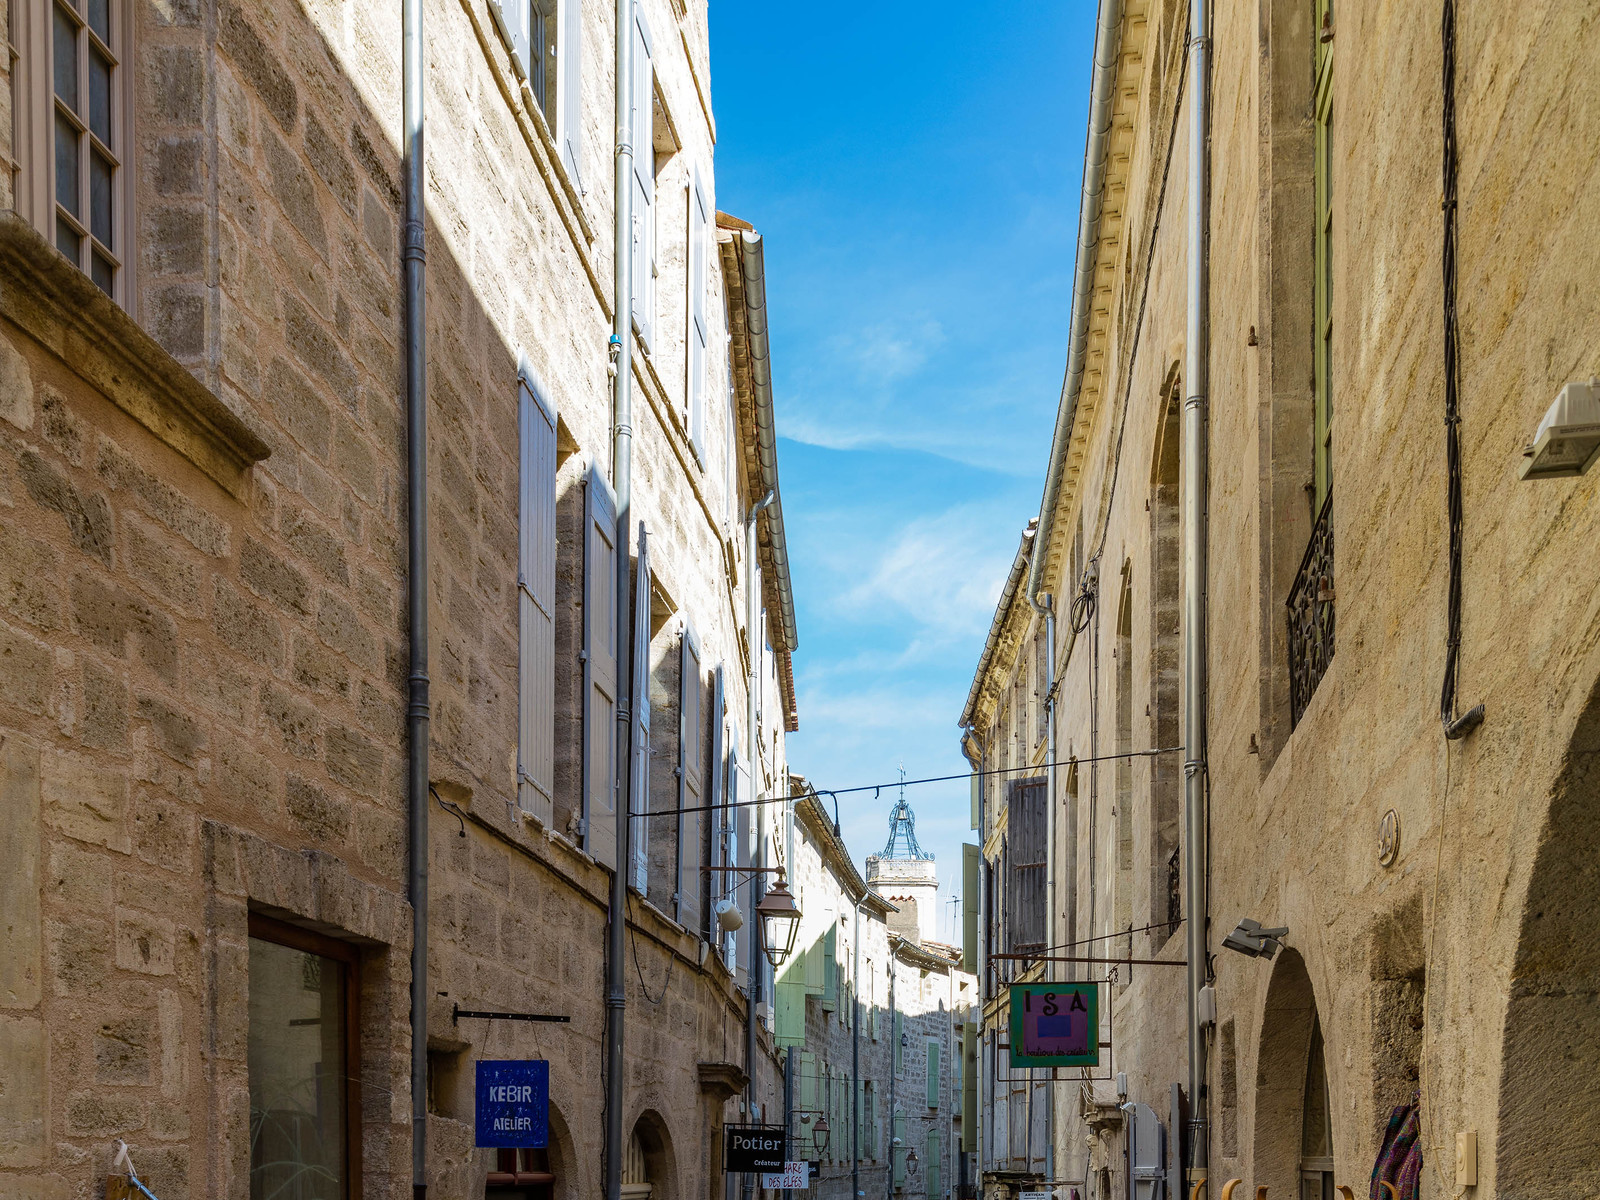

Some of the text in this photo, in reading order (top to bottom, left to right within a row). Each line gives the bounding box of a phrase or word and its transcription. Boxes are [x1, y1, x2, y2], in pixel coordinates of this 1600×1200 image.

[1025, 989, 1087, 1016] ISA
[1016, 1045, 1023, 1057] la
[1026, 1045, 1053, 1057] boutique
[1055, 1045, 1065, 1056] des
[733, 1135, 781, 1151] Potier
[784, 1163, 802, 1175] HARE
[768, 1175, 803, 1188] DES ELFES
